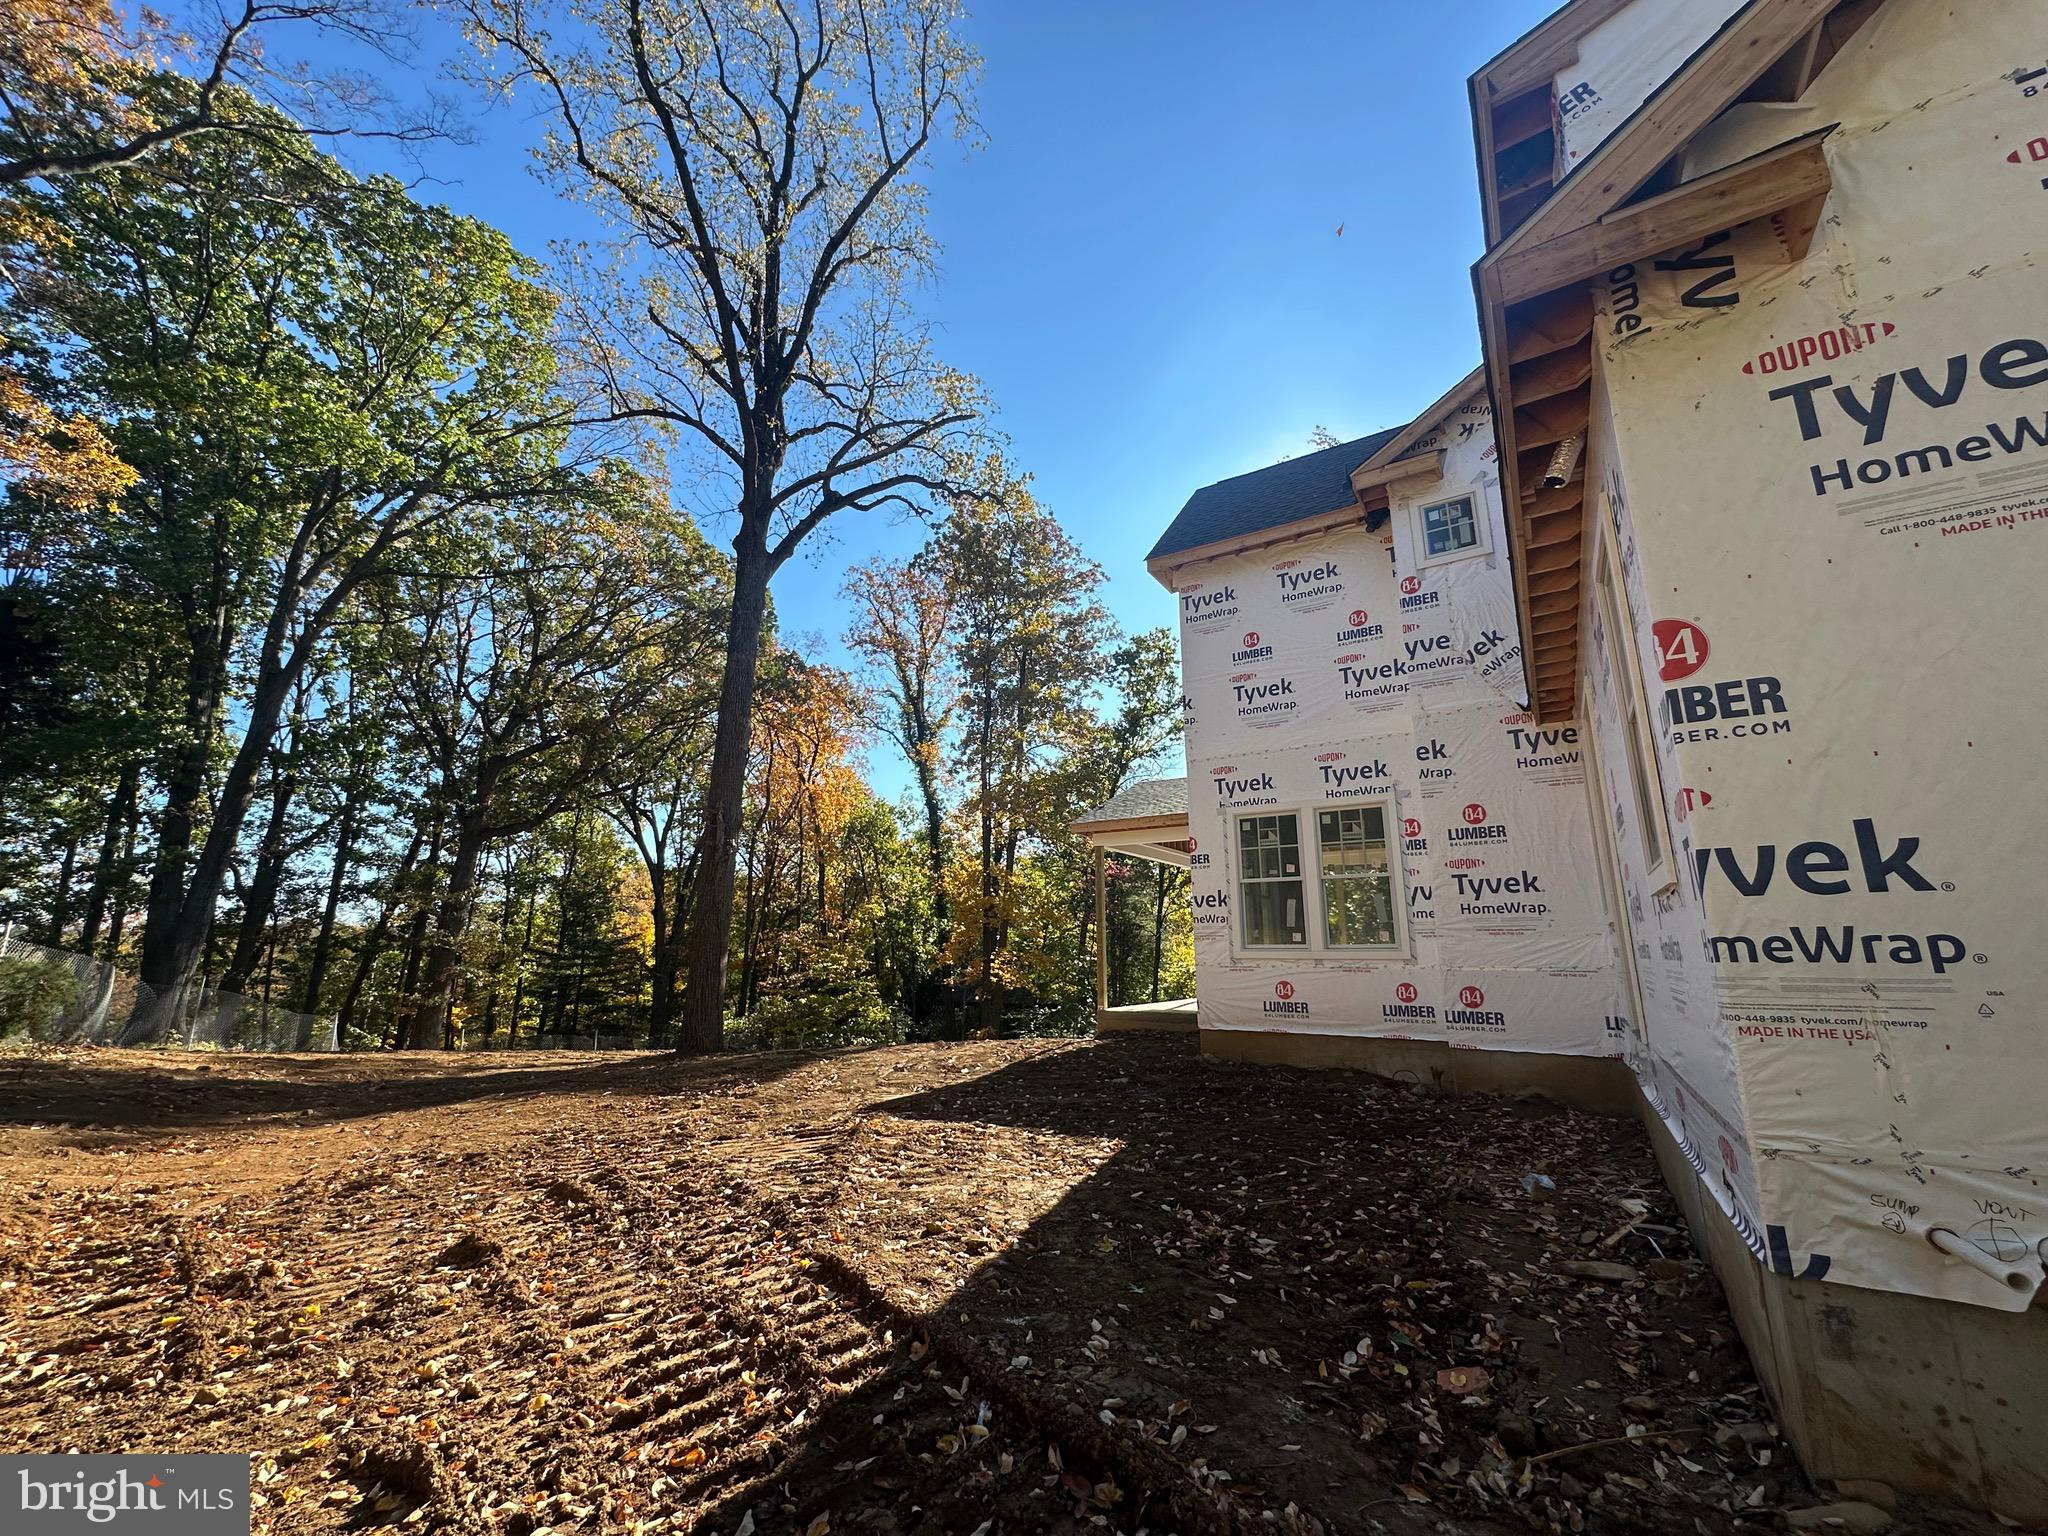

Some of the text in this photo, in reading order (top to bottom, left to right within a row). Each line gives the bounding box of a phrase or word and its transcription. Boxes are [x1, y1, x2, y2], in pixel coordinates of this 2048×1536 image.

[1759, 322, 1876, 374] DUPONT
[1879, 525, 1901, 536] Call
[1904, 506, 1997, 531] 1-800-448-9835
[1941, 519, 1992, 537] MADE
[1996, 513, 2016, 526] IN
[1275, 559, 1298, 571] DUPONT
[1276, 562, 1338, 591] Tyvek
[1282, 583, 1342, 603] HomeWrap
[1402, 578, 1419, 592] 84
[1181, 586, 1236, 613] Tyvek
[1185, 607, 1238, 624] HomeWrap
[1350, 611, 1366, 625] 84
[1244, 633, 1259, 647] 84
[1337, 624, 1383, 642] LUMBER
[1232, 646, 1273, 662] LUMBER
[1337, 653, 1362, 665] DUPONT
[1231, 672, 1254, 683] DUPONT
[1338, 658, 1407, 688] Tyvek
[1233, 678, 1293, 705] Tyvek
[1238, 701, 1297, 716] HomeWrap
[1317, 752, 1343, 762] DUPONT
[1319, 759, 1388, 787] Tyvek
[1214, 773, 1274, 799] Tyvek
[1463, 806, 1486, 822] 84
[1447, 825, 1507, 841] LUMBER
[1449, 839, 1508, 847] 84LUMBER.COM
[1449, 858, 1482, 869] DUPONT
[1451, 870, 1541, 901] Tyvek
[1460, 901, 1547, 917] HomeWrap
[1277, 983, 1292, 997] 84
[1397, 985, 1416, 1000] 84
[1461, 989, 1483, 1006] 84
[1263, 1001, 1309, 1013] LUMBER
[1382, 1005, 1435, 1018] LUMBER
[1444, 1010, 1505, 1026] LUMBER
[1722, 1013, 1796, 1024] 00-448-9835
[1738, 1026, 1876, 1041] MADE IN THE USA
